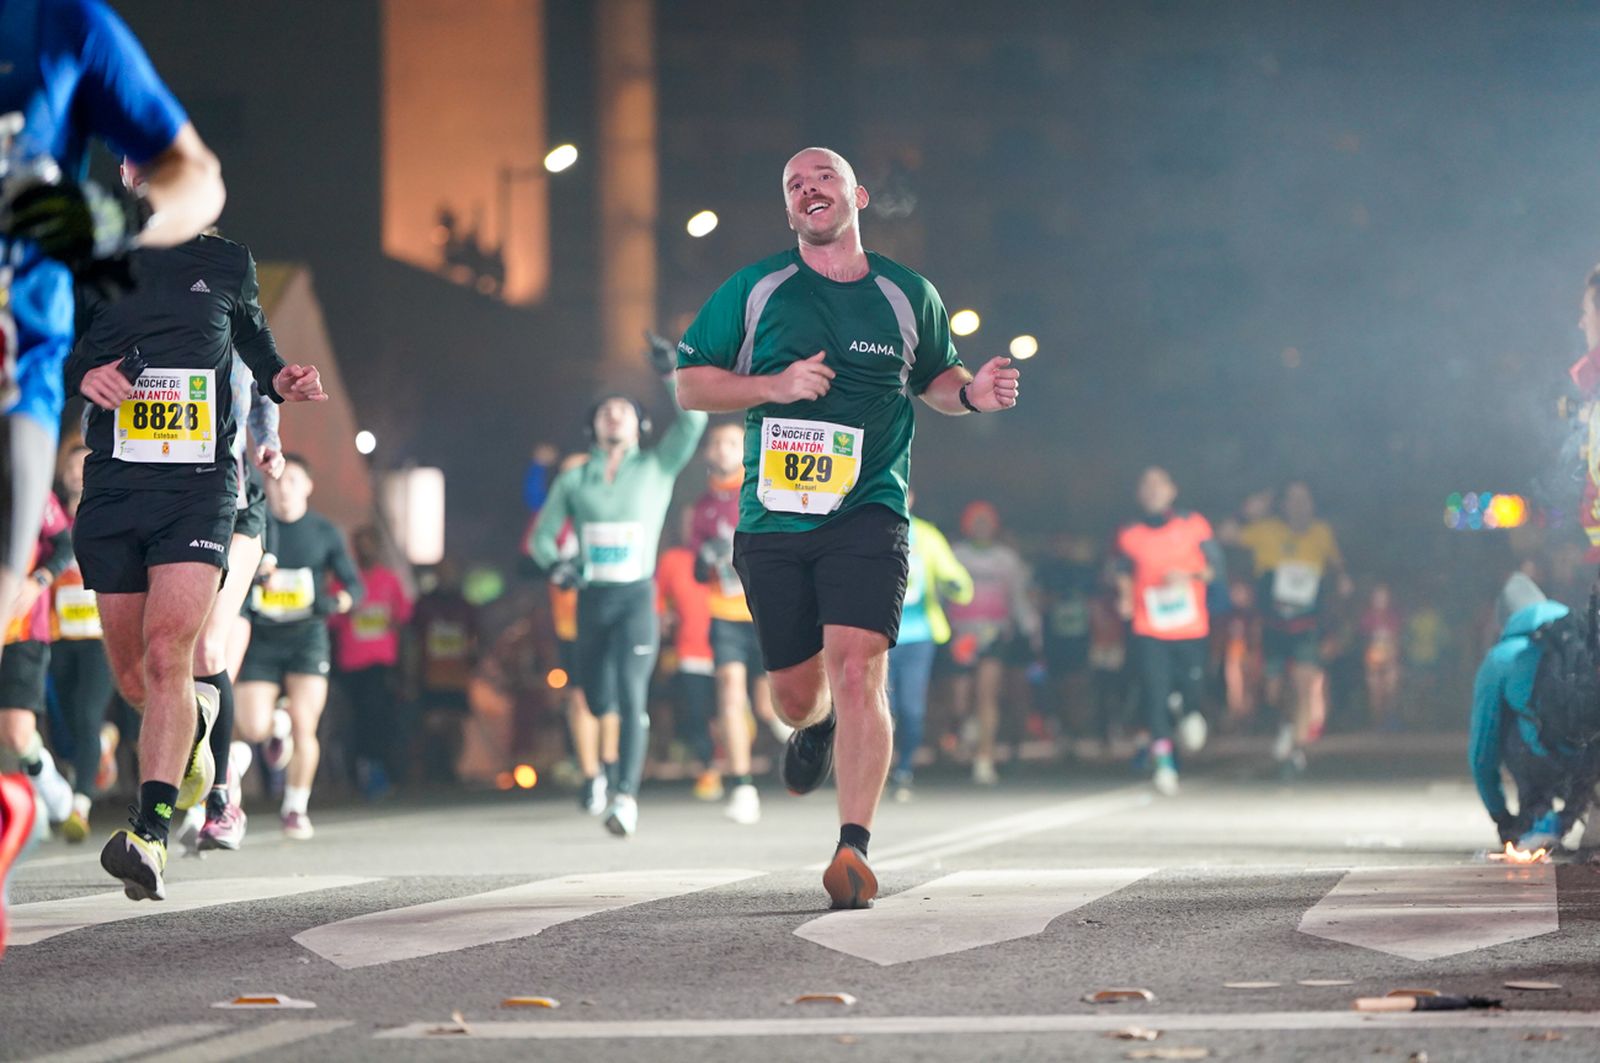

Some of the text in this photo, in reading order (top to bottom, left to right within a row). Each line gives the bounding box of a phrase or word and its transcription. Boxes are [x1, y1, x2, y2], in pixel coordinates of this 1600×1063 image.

[849, 340, 895, 356] ADAMA
[137, 379, 181, 388] NOCHE DE
[147, 388, 181, 400] ANTÓN
[133, 402, 198, 430] 8828
[781, 430, 811, 441] NOCHE
[812, 431, 825, 441] DE
[771, 439, 789, 450] SAN
[790, 441, 824, 453] ANTÓN
[785, 453, 833, 483] 829
[794, 483, 817, 491] Manuel
